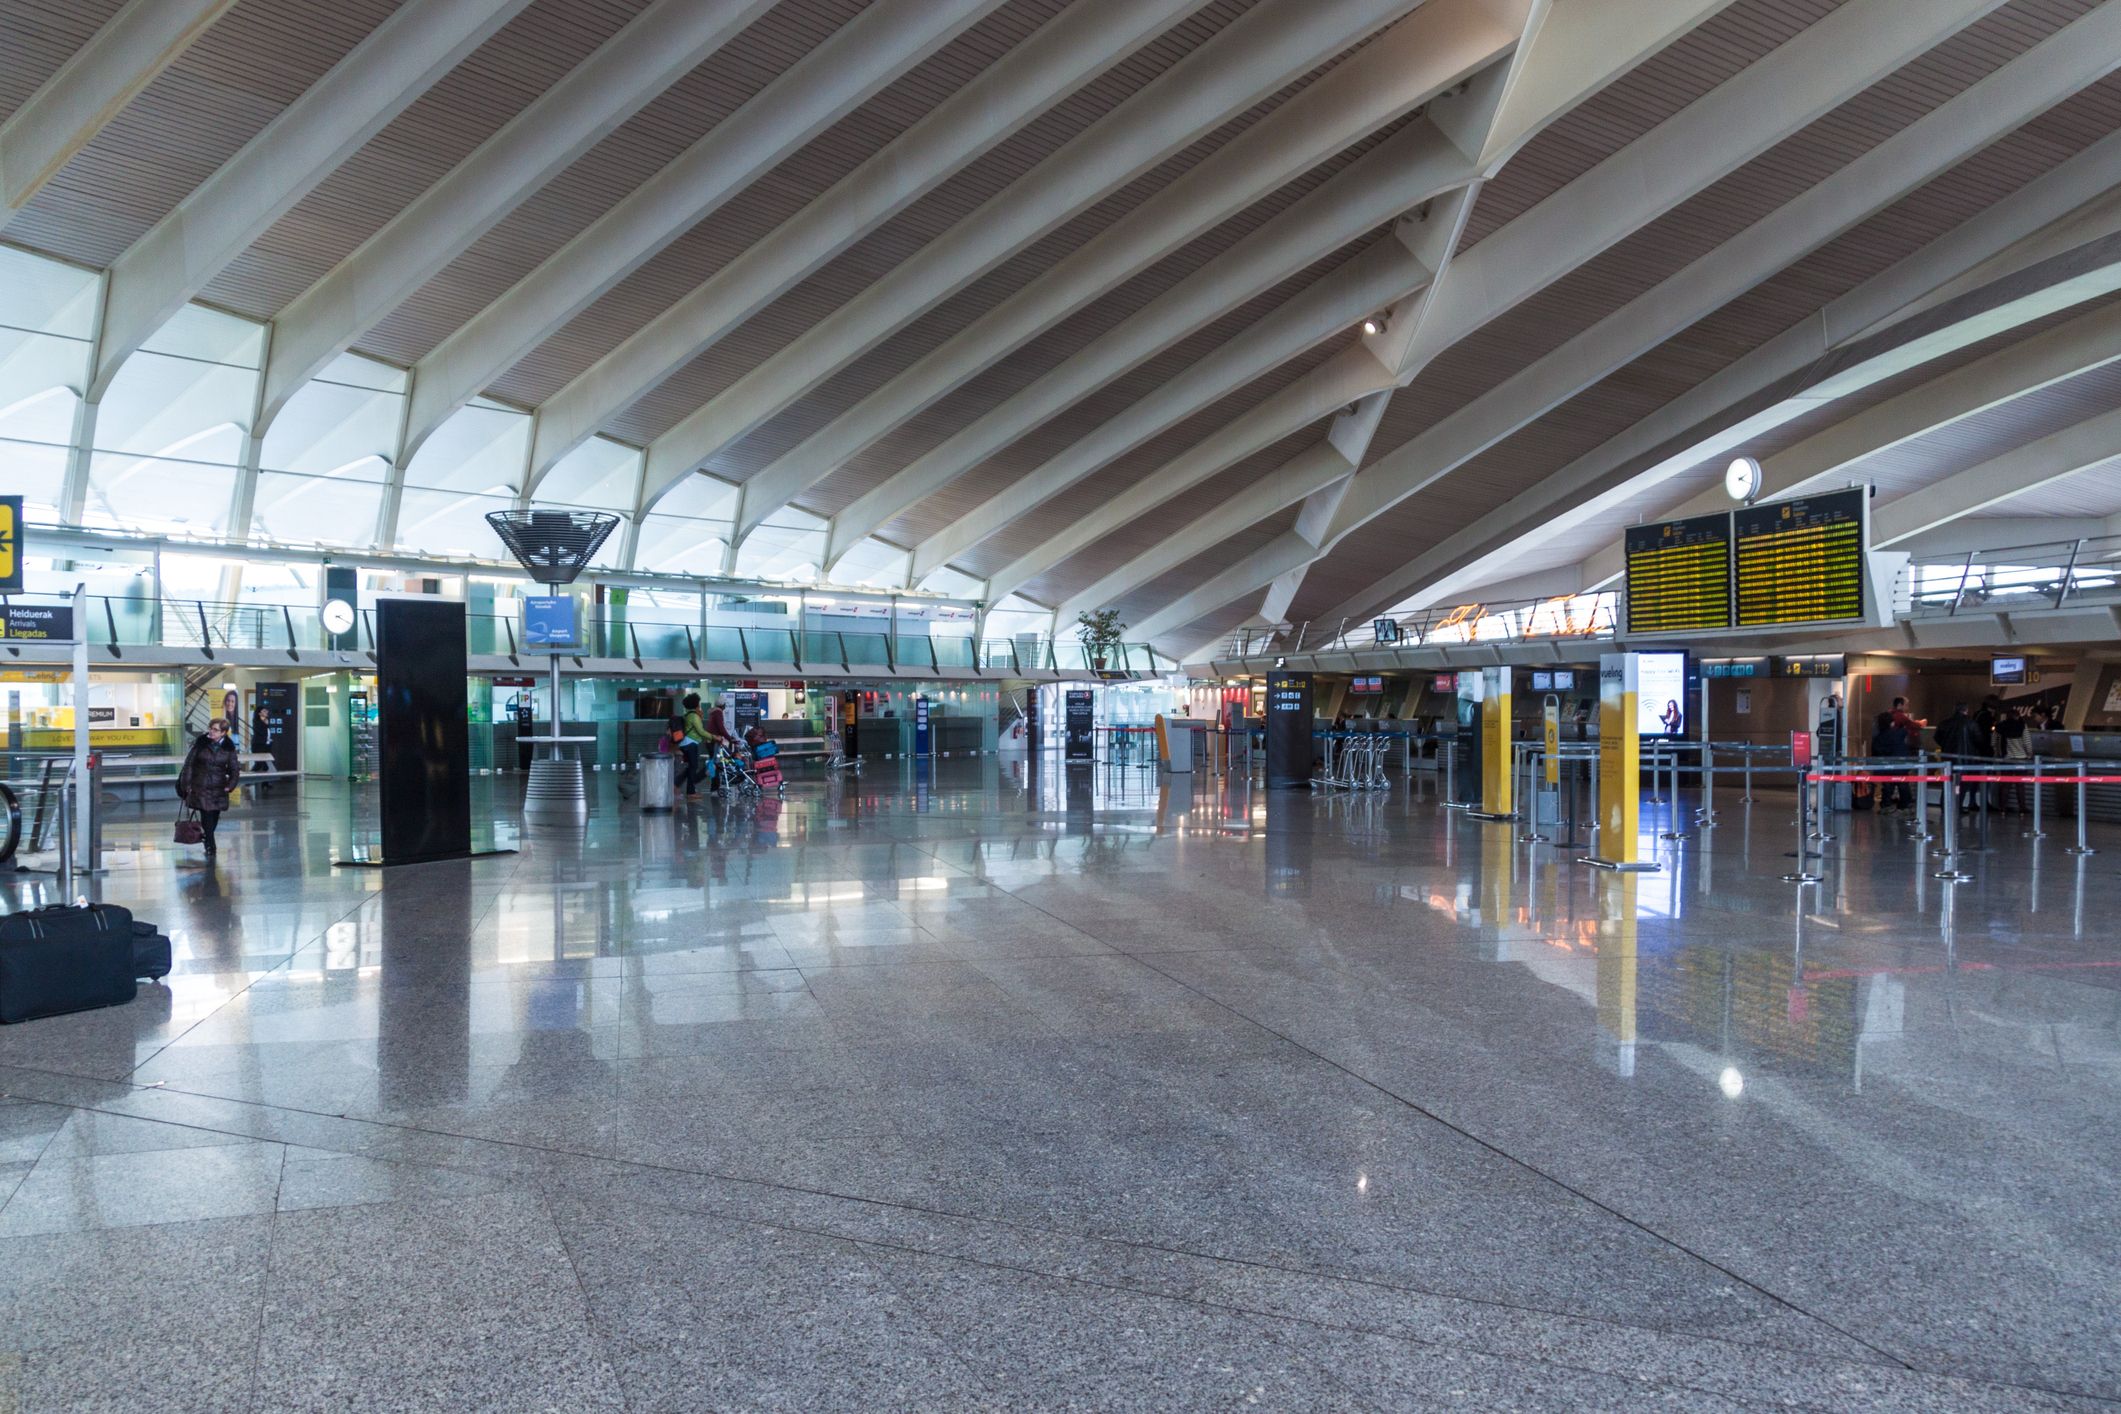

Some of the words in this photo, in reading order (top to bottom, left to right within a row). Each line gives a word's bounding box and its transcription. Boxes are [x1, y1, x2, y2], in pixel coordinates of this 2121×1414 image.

[9, 609, 53, 619] Helduerak
[9, 619, 37, 628] Arrivals
[10, 629, 48, 639] Llegadas
[1600, 665, 1624, 682] vueling
[2028, 672, 2040, 682] 10
